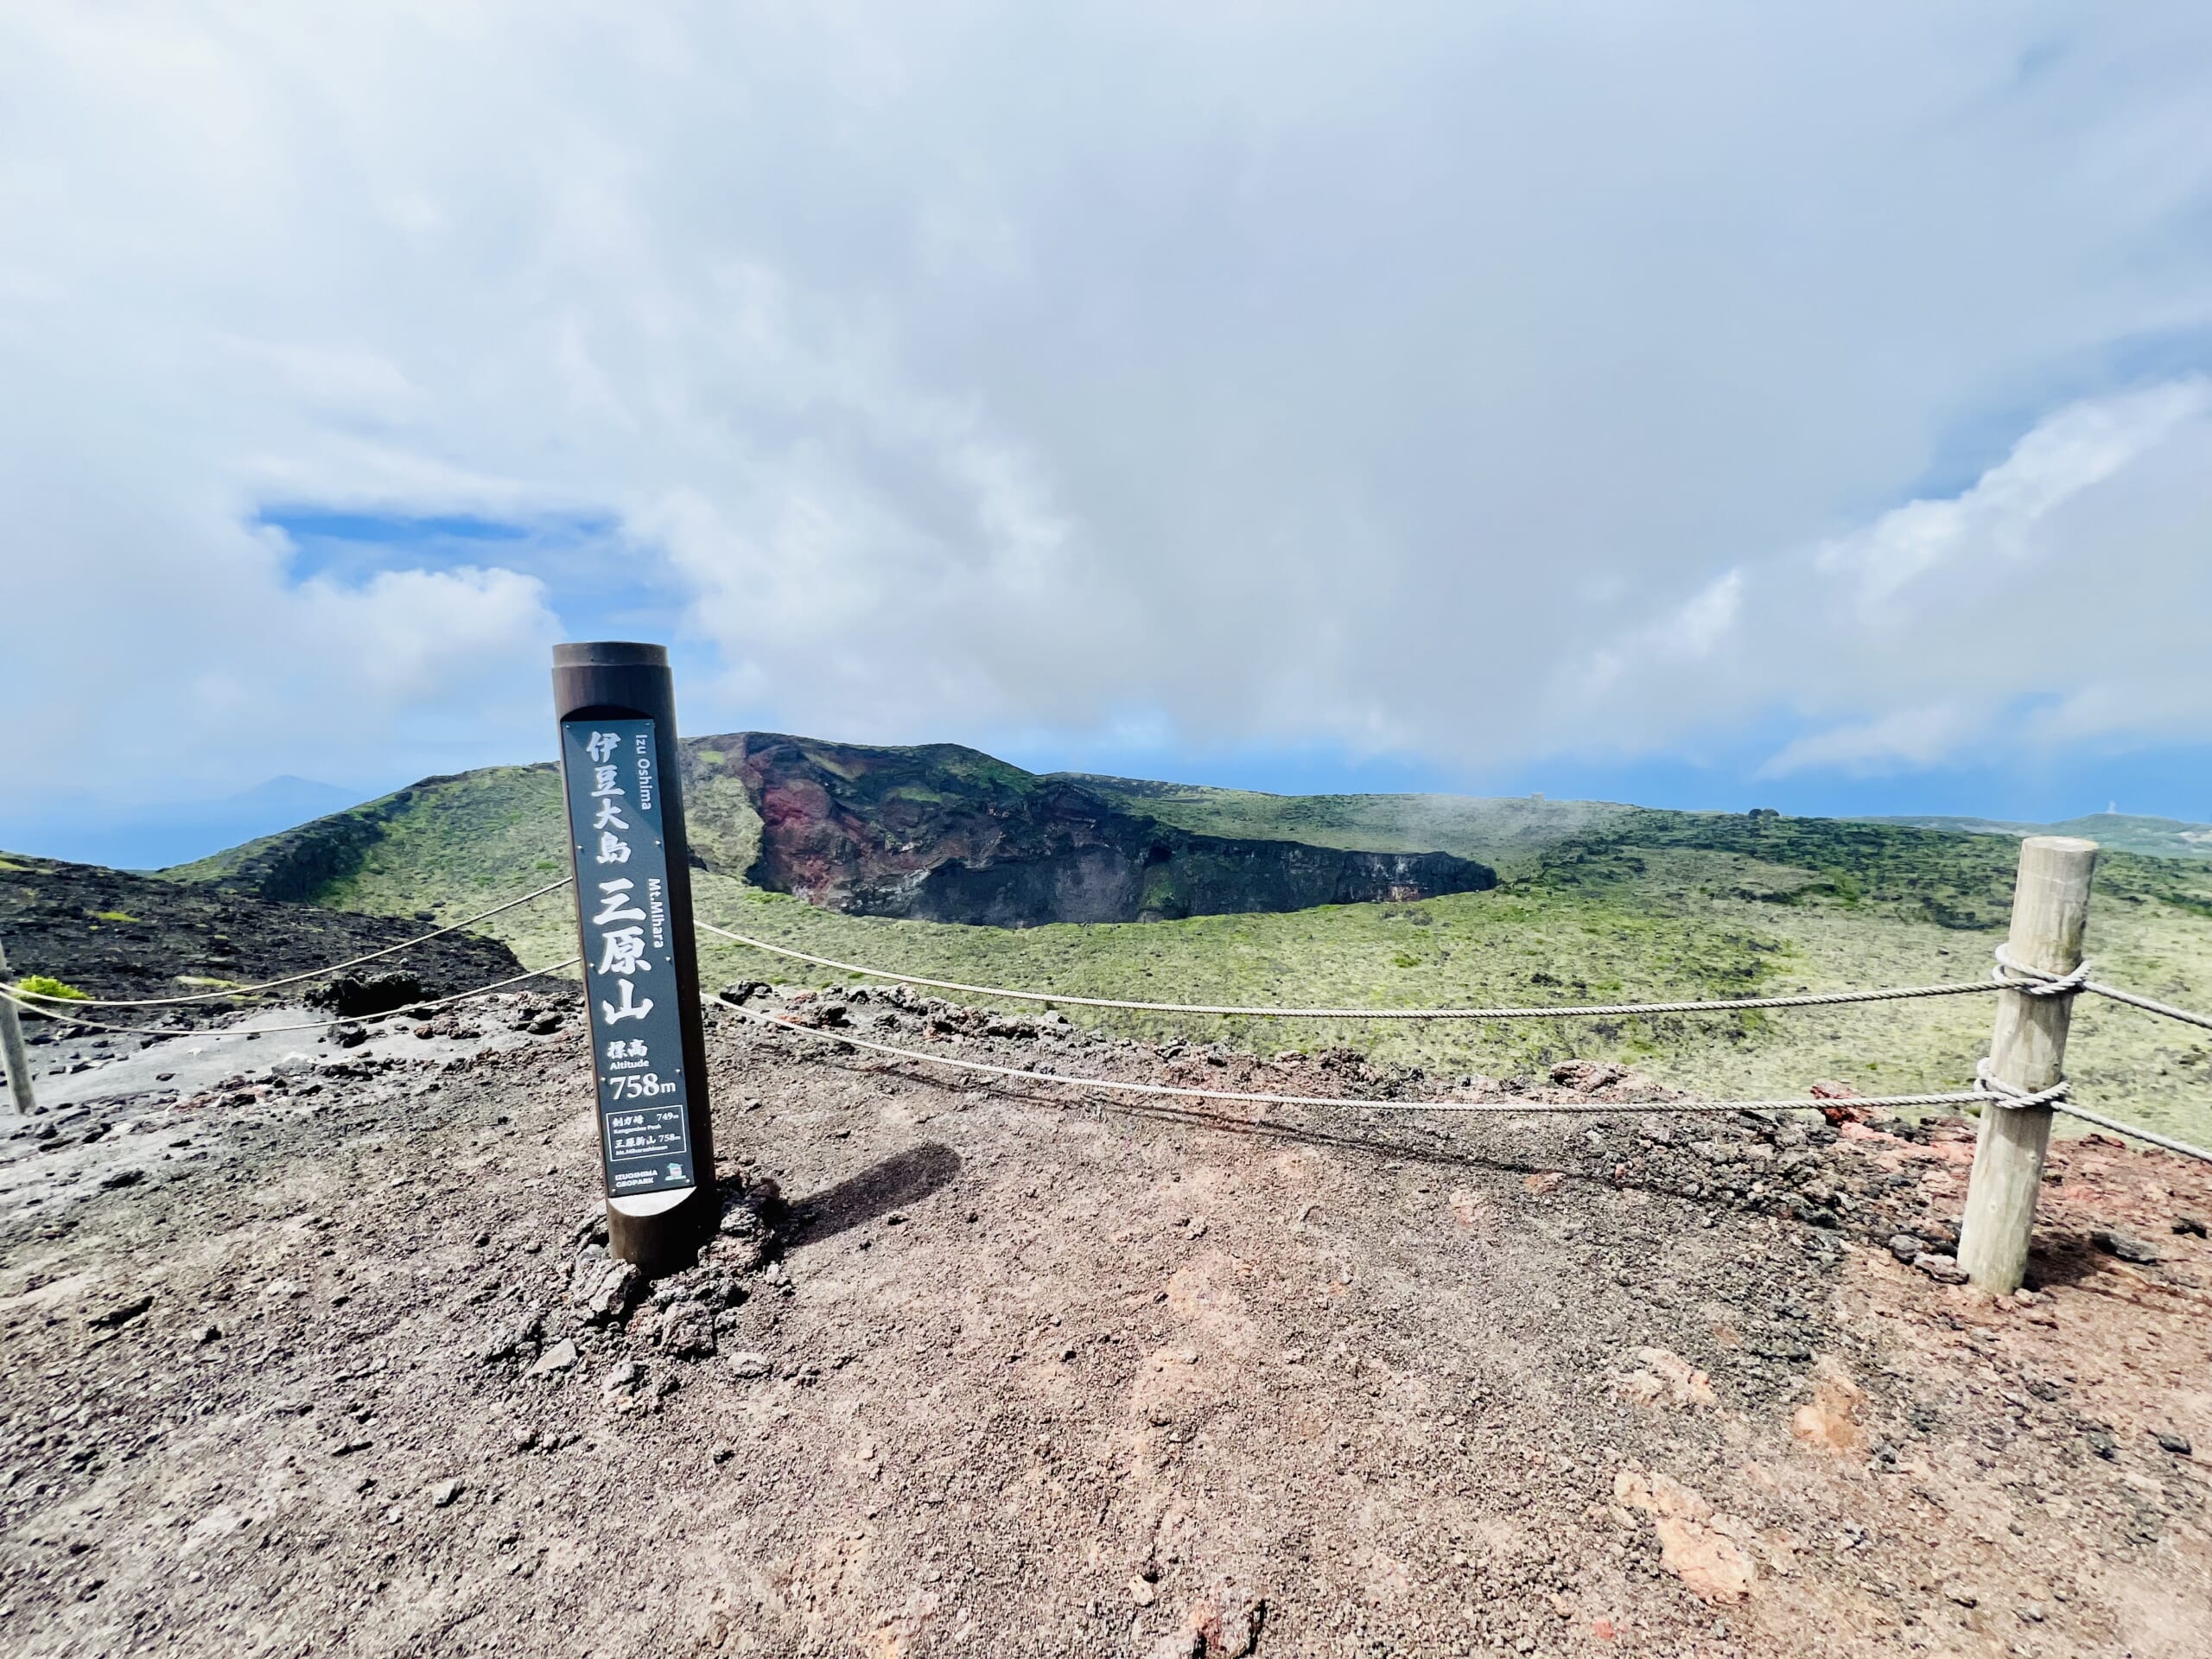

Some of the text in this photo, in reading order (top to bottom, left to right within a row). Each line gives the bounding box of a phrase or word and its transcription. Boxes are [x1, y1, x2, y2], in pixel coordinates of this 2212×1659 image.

[635, 734, 653, 810] Izu Oshima
[586, 730, 654, 1026] 伊豆大島 三原山
[648, 878, 664, 949] Mt.Mihara
[607, 1039, 648, 1059] 標高
[610, 1058, 650, 1071] Altitude
[609, 1072, 677, 1100] 758m
[616, 1177, 654, 1188] GEOPARK
